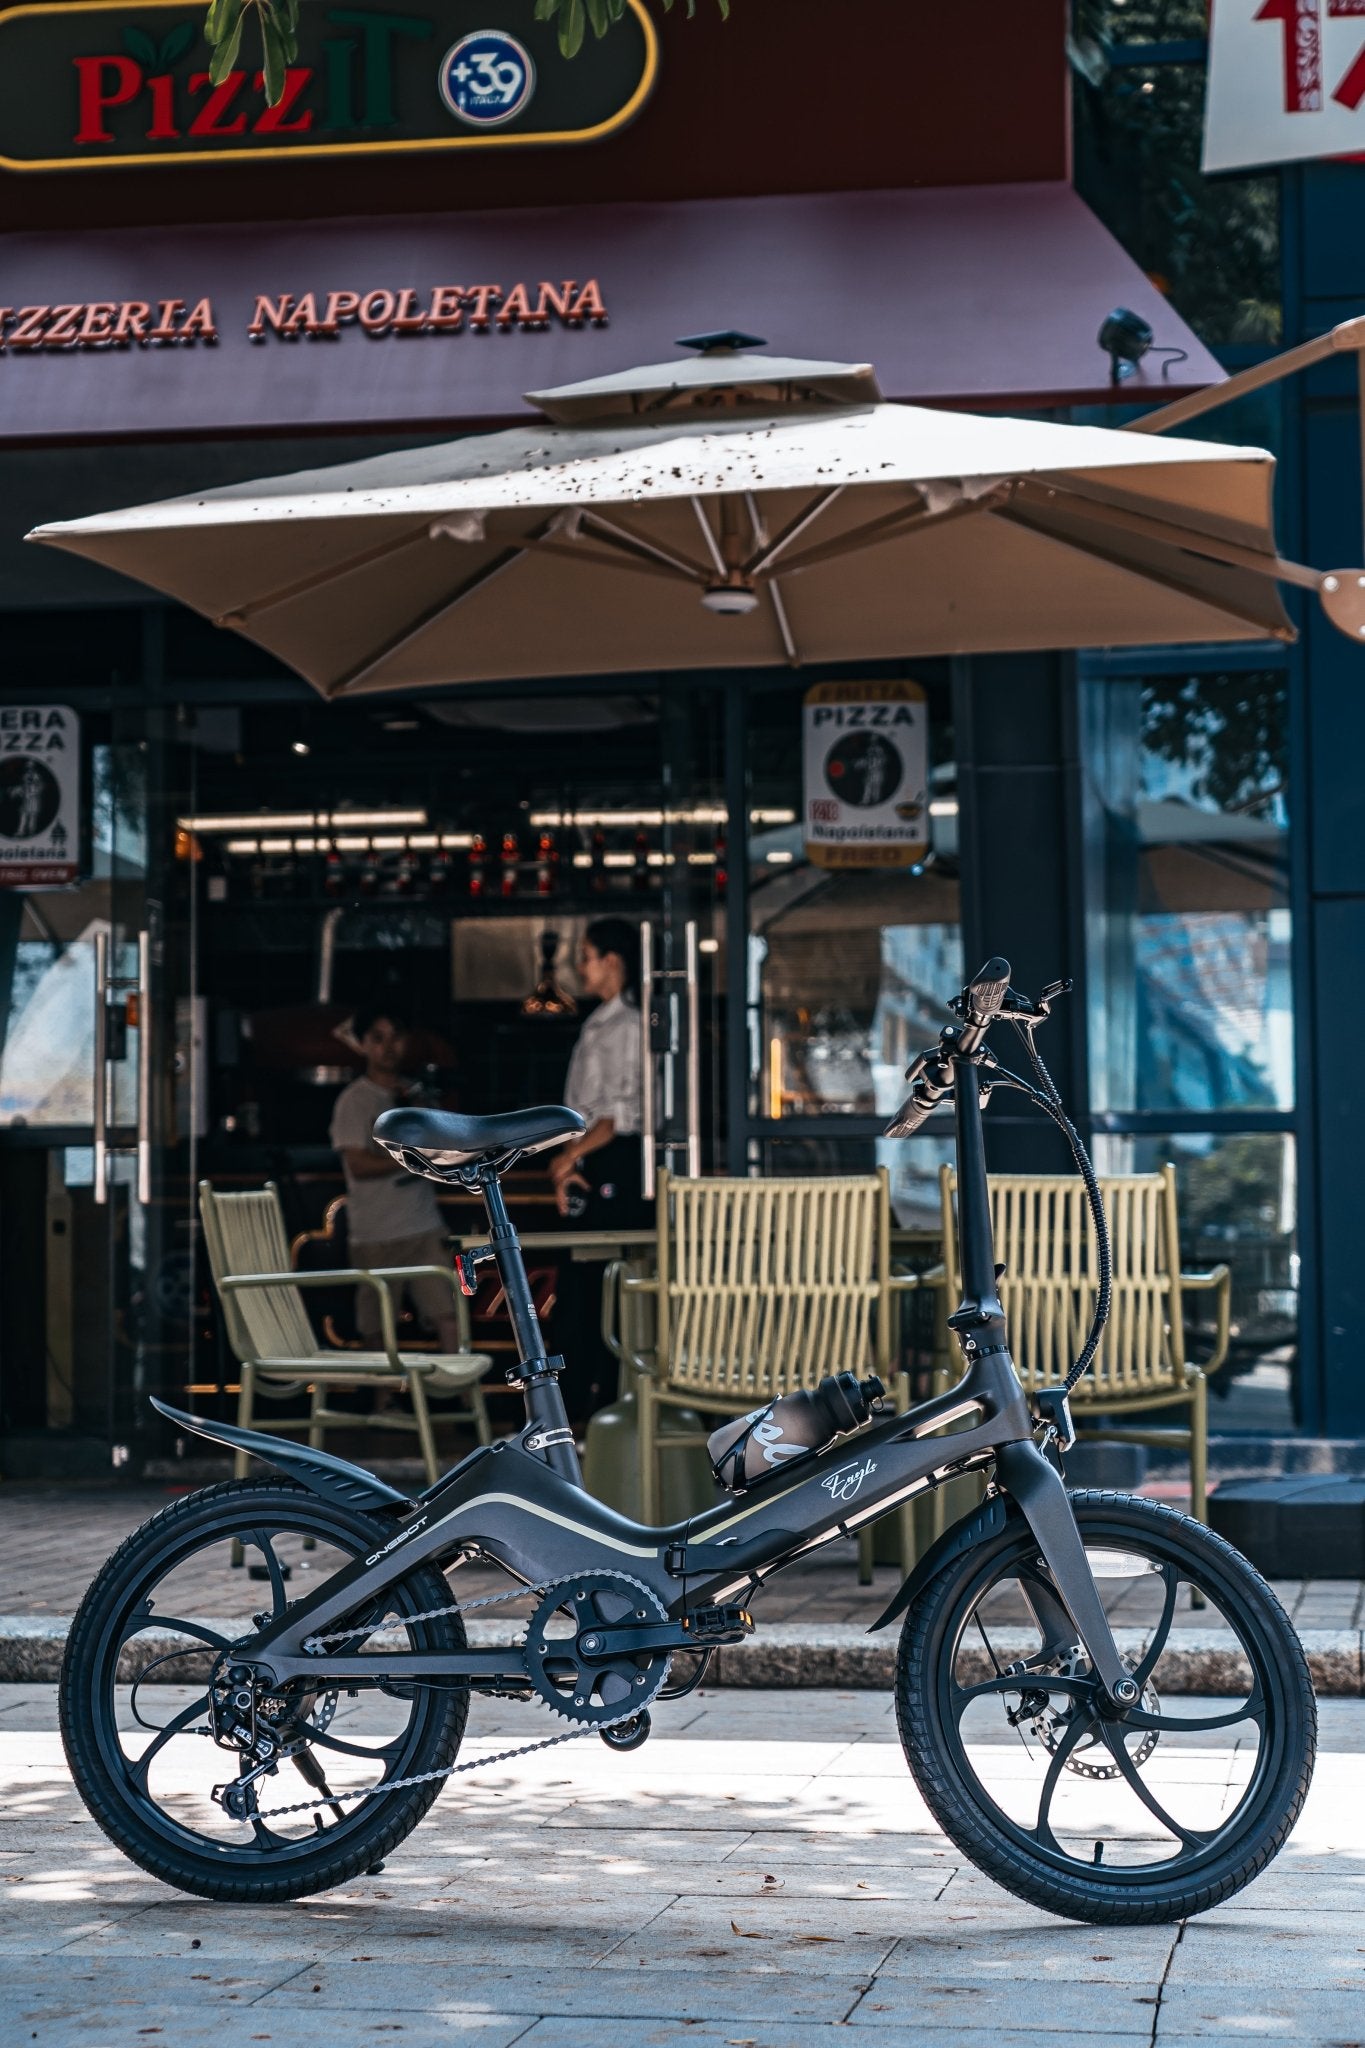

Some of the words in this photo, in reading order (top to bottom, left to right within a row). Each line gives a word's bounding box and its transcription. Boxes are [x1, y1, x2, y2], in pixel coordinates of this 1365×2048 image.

[247, 279, 609, 341] NAPOLETANA
[813, 705, 914, 727] PIZZA
[0, 732, 66, 752] ZZA
[820, 1458, 878, 1500] Eagle
[365, 1515, 428, 1566] ONEBOT
